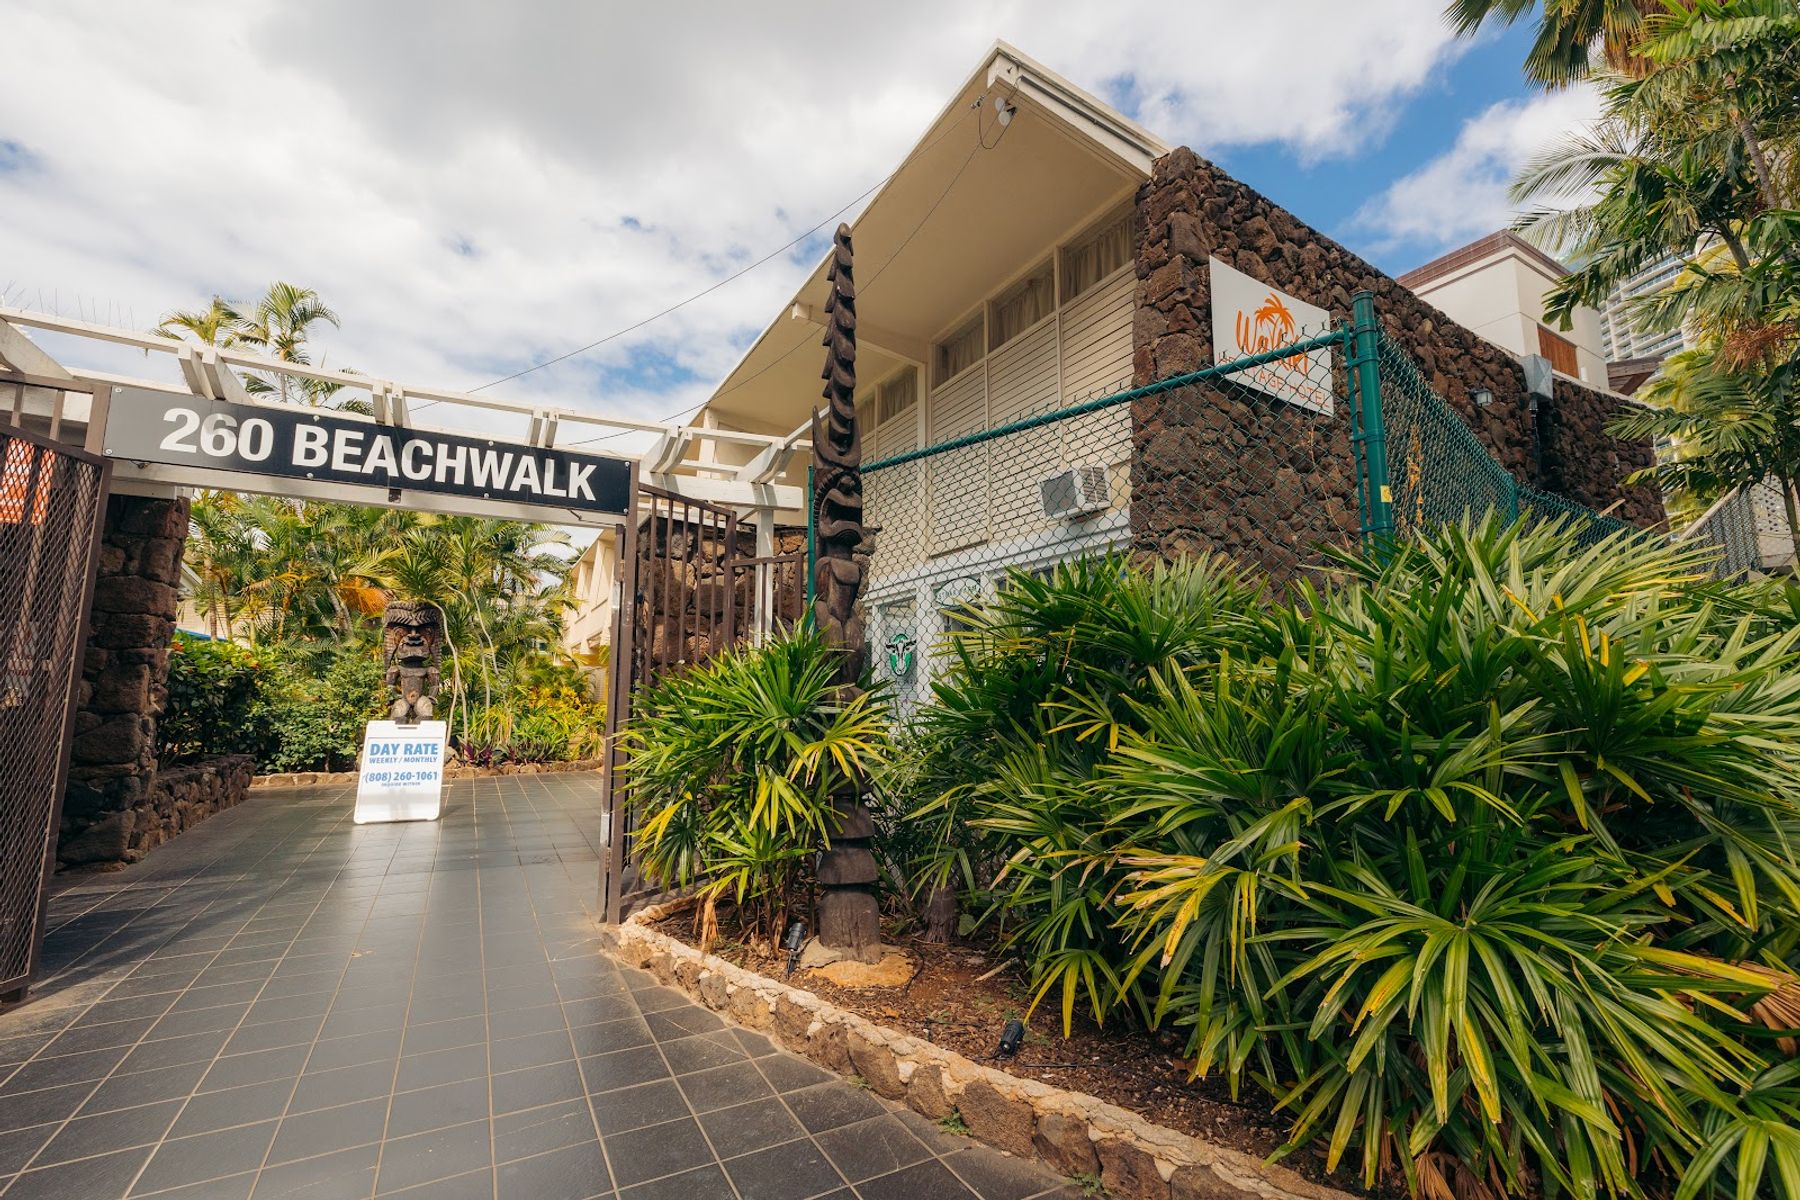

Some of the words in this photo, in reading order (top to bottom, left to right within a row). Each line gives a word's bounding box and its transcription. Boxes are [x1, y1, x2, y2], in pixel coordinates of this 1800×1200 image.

[159, 407, 274, 462] 260
[291, 422, 598, 502] BEACHWALK
[369, 743, 400, 756] DAY
[403, 743, 438, 755] RATE
[365, 772, 392, 783] (808)
[393, 771, 438, 781] 260-1061
